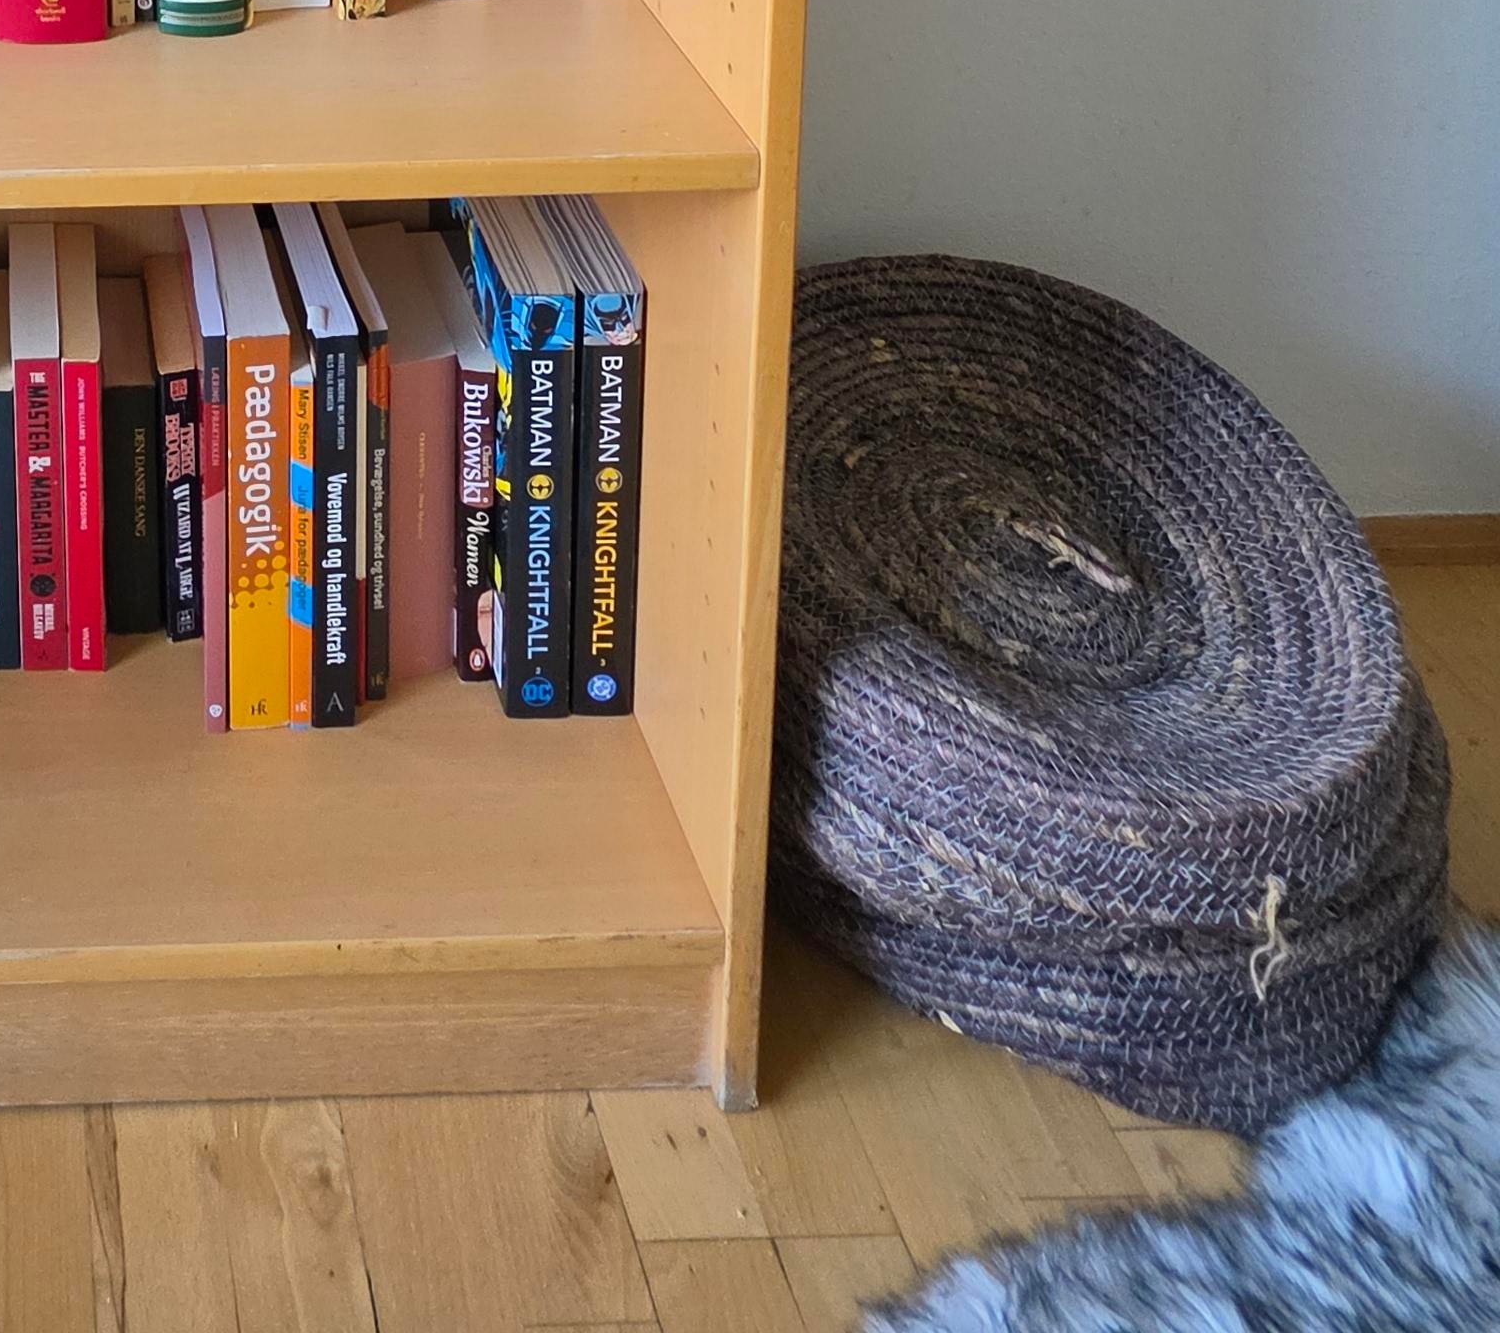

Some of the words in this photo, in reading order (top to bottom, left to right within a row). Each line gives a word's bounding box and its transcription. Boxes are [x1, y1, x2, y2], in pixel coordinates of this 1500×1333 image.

[238, 363, 277, 558] Pædagogik
[462, 380, 489, 505] Bukowski
[530, 359, 553, 468] BATMAN
[597, 355, 623, 463] BATMAN
[322, 547, 343, 569] og
[327, 472, 348, 544] Vovemod
[466, 511, 490, 588] Women
[325, 571, 347, 666] handlekraft
[527, 504, 551, 660] KNIGHTFALL
[592, 501, 619, 656] KNIGHTFALL
